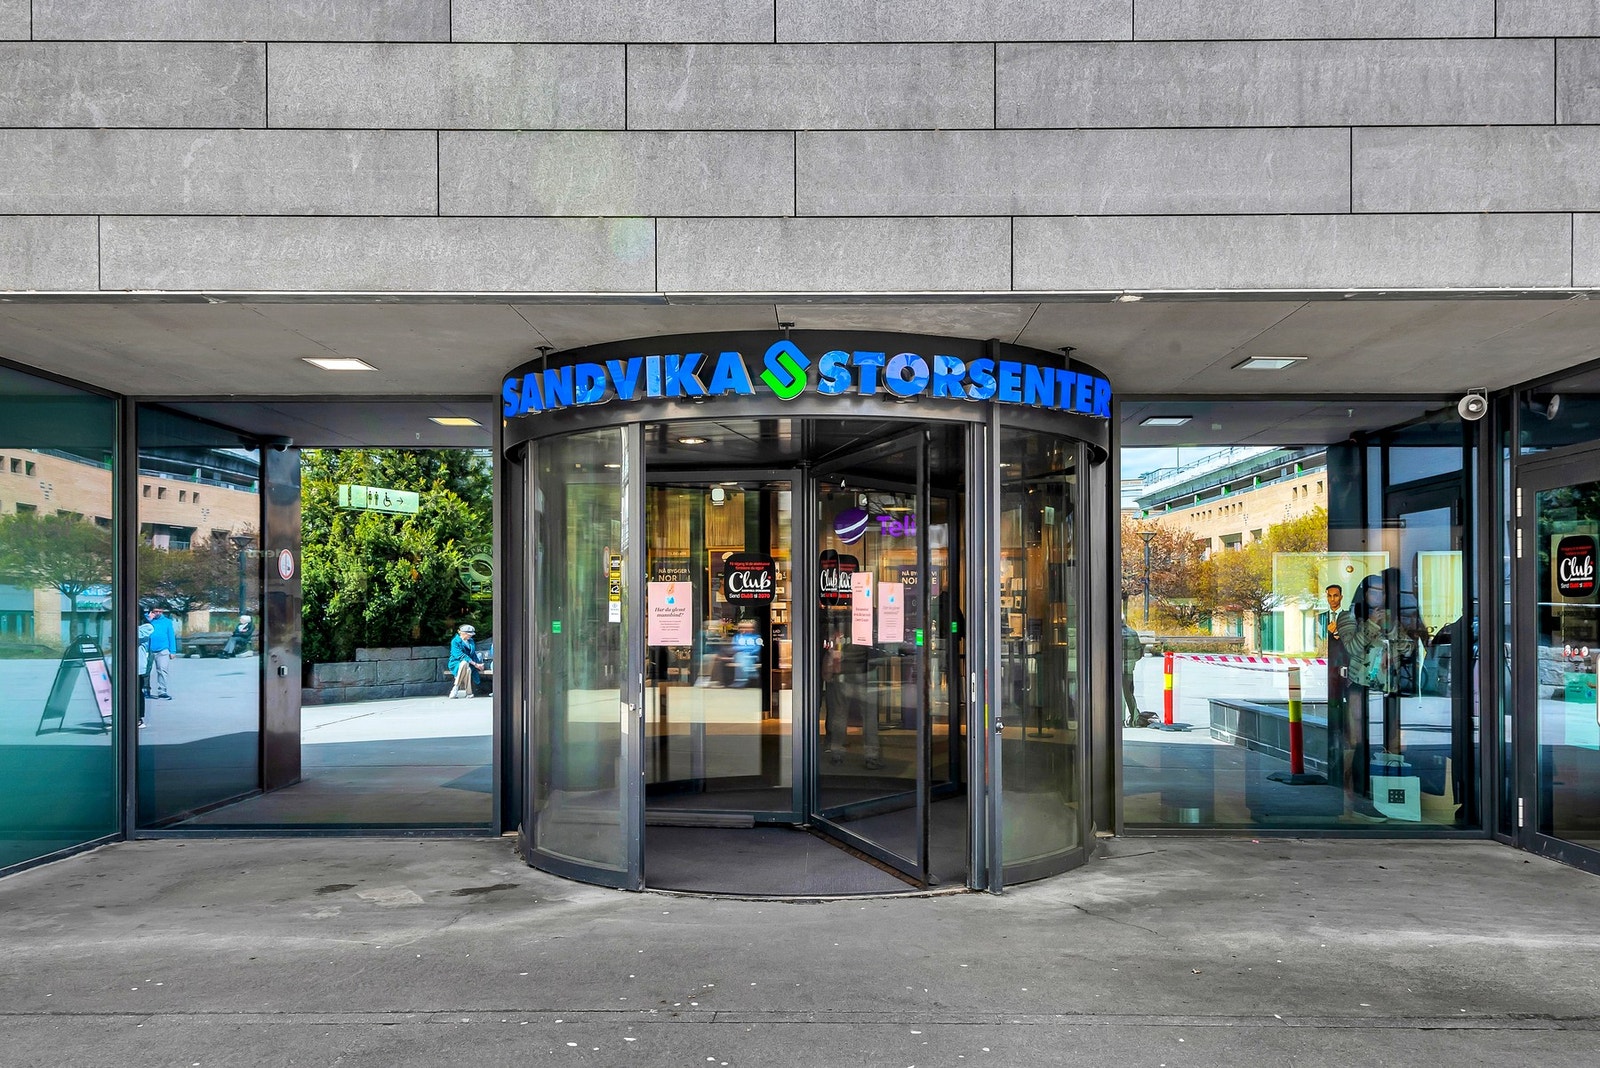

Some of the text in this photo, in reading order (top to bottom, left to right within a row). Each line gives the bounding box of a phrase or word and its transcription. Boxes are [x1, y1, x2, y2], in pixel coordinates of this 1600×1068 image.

[502, 350, 1111, 418] SANDVIKA STORSENTER
[876, 513, 916, 538] Teli
[820, 568, 838, 591] Club
[1560, 555, 1593, 582] Club
[728, 571, 771, 592] Club
